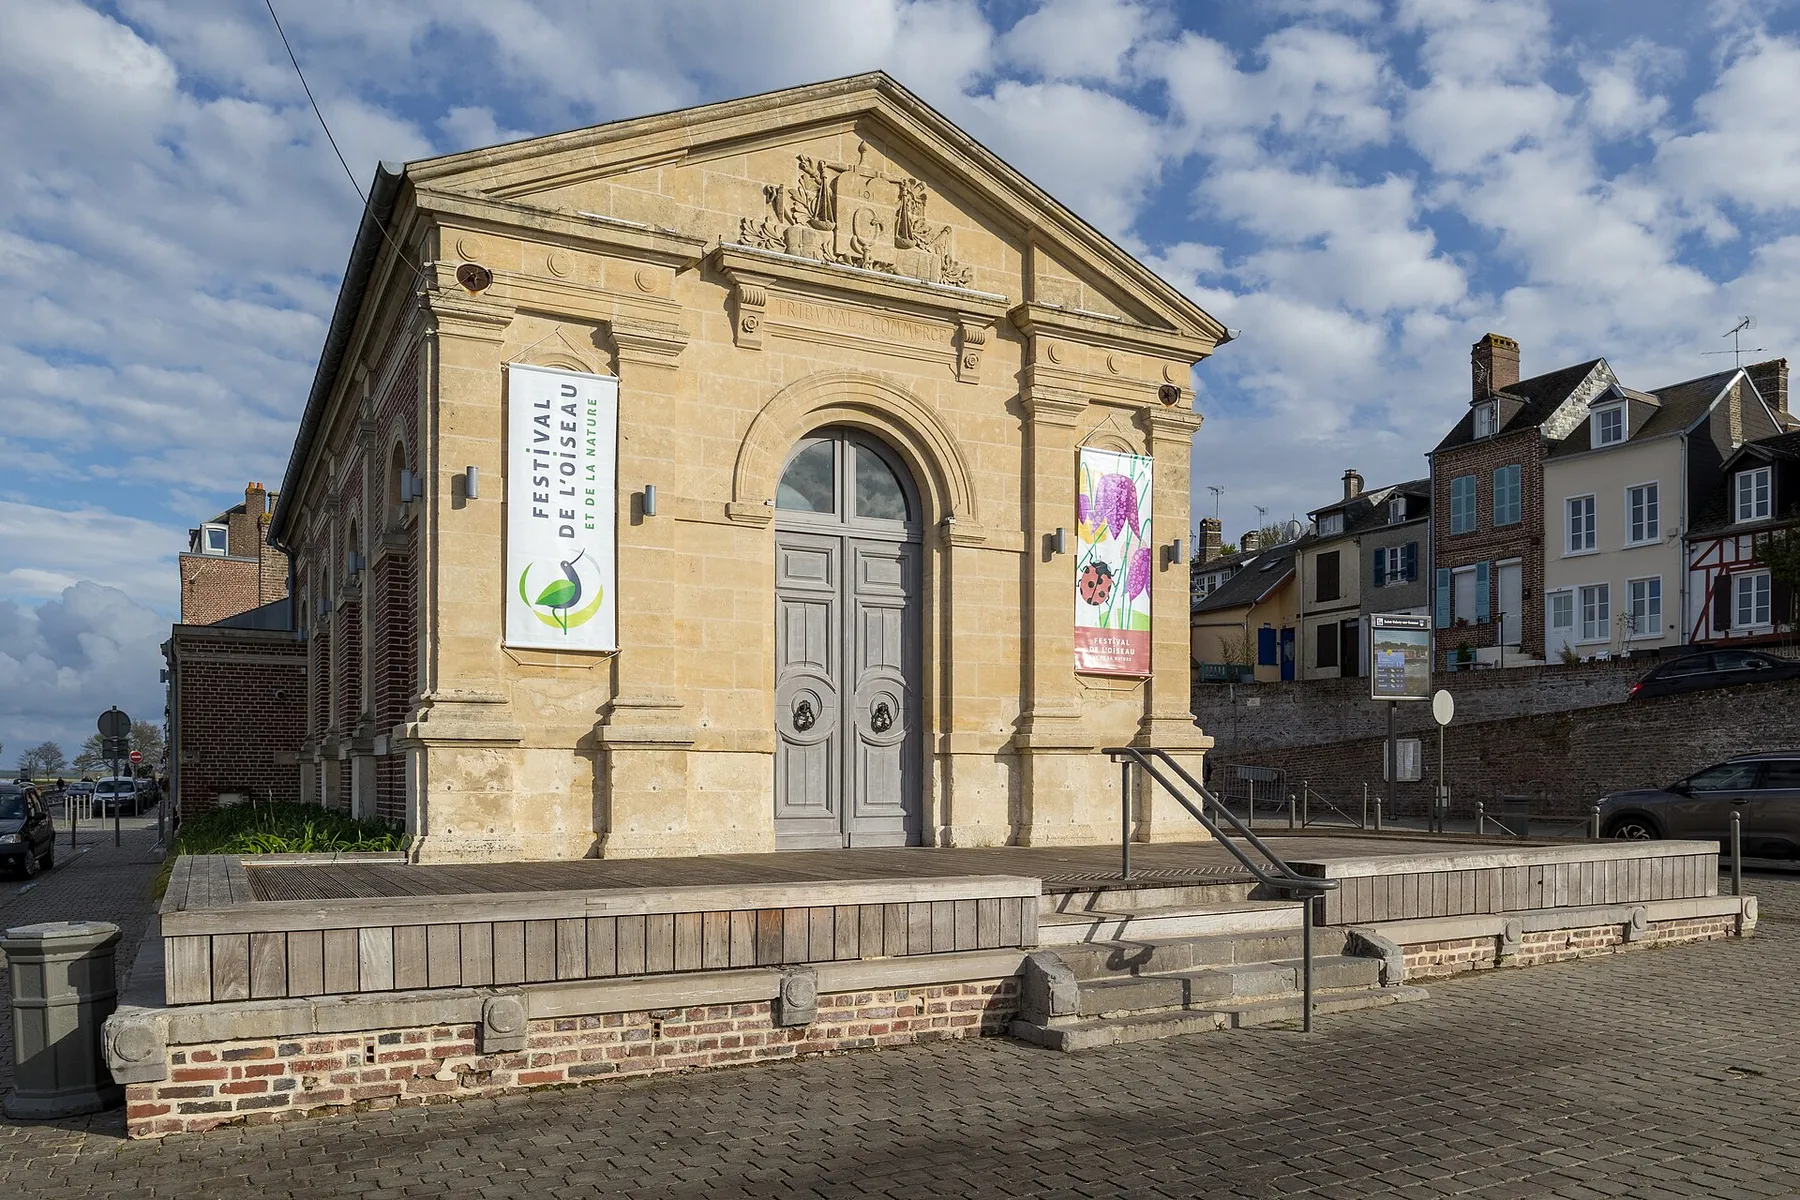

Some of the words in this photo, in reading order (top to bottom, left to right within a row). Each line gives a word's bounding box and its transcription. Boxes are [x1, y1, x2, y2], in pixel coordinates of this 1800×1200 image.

[872, 315, 948, 343] COMMERCE
[586, 398, 597, 457] NATURE
[586, 464, 596, 481] LA
[585, 488, 595, 506] DE
[559, 508, 575, 539] DE
[585, 513, 595, 530] ET
